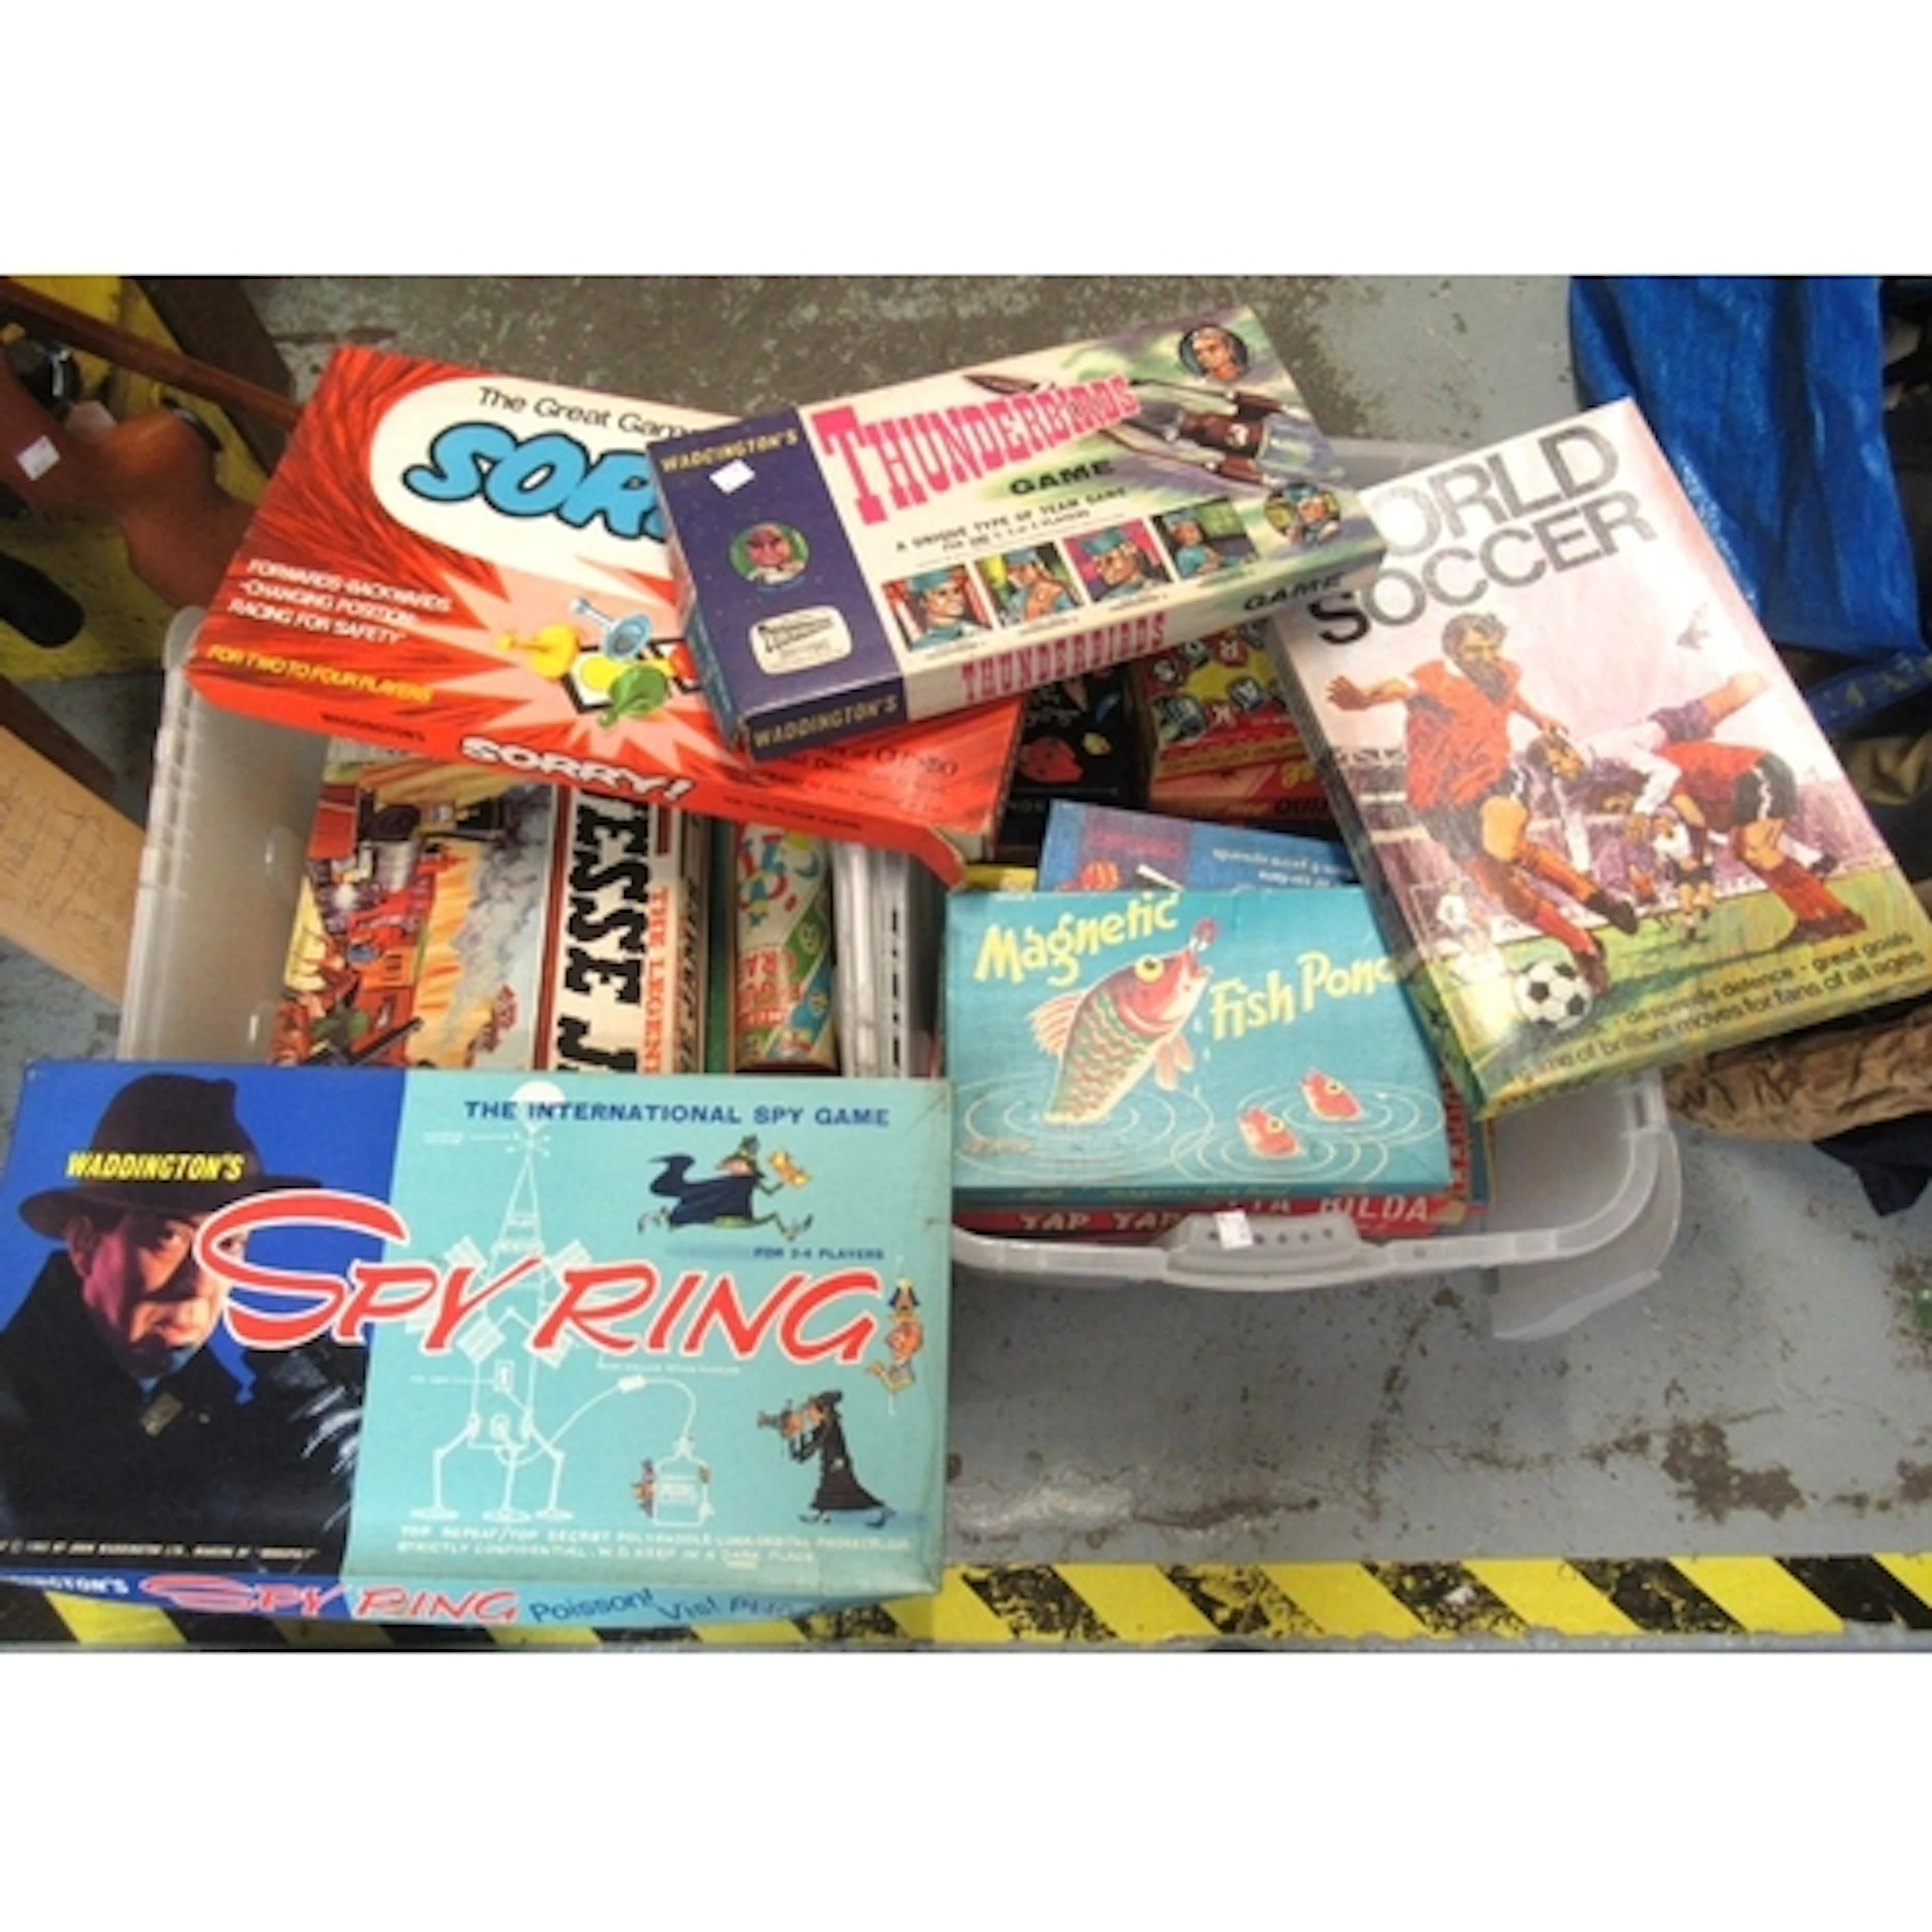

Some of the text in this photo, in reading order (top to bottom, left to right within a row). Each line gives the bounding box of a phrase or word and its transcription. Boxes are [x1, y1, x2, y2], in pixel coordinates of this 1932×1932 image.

[478, 386, 688, 439] The Great Gam
[659, 429, 798, 473] WADDINGTON'S
[811, 374, 1141, 525] THUNDERBIRDS
[1009, 460, 1113, 495] GAME
[1370, 426, 1619, 556] ORLD
[1244, 573, 1345, 611] GAME
[1309, 490, 1657, 645] SOCCER
[228, 597, 293, 624] RACING
[294, 613, 331, 633] FOR
[207, 644, 433, 703] FOR TWO TO FOUR PLAYERS
[960, 611, 1166, 703] THUNDERBIRDS
[754, 694, 899, 748] WADDINGTON'S
[460, 734, 696, 801] SORRY!
[565, 789, 650, 1004] ESSE
[648, 887, 668, 946] THE
[974, 891, 1180, 987] Magnetic
[1812, 947, 1860, 973] great
[1210, 974, 1295, 1040] Fish
[464, 1101, 890, 1127] THE INTERNATIONAL SPY GAME
[65, 1151, 246, 1182] WADDINGTON'S
[194, 1189, 883, 1365] SPY RING
[139, 1574, 347, 1616] SPY
[355, 1585, 520, 1623] RING
